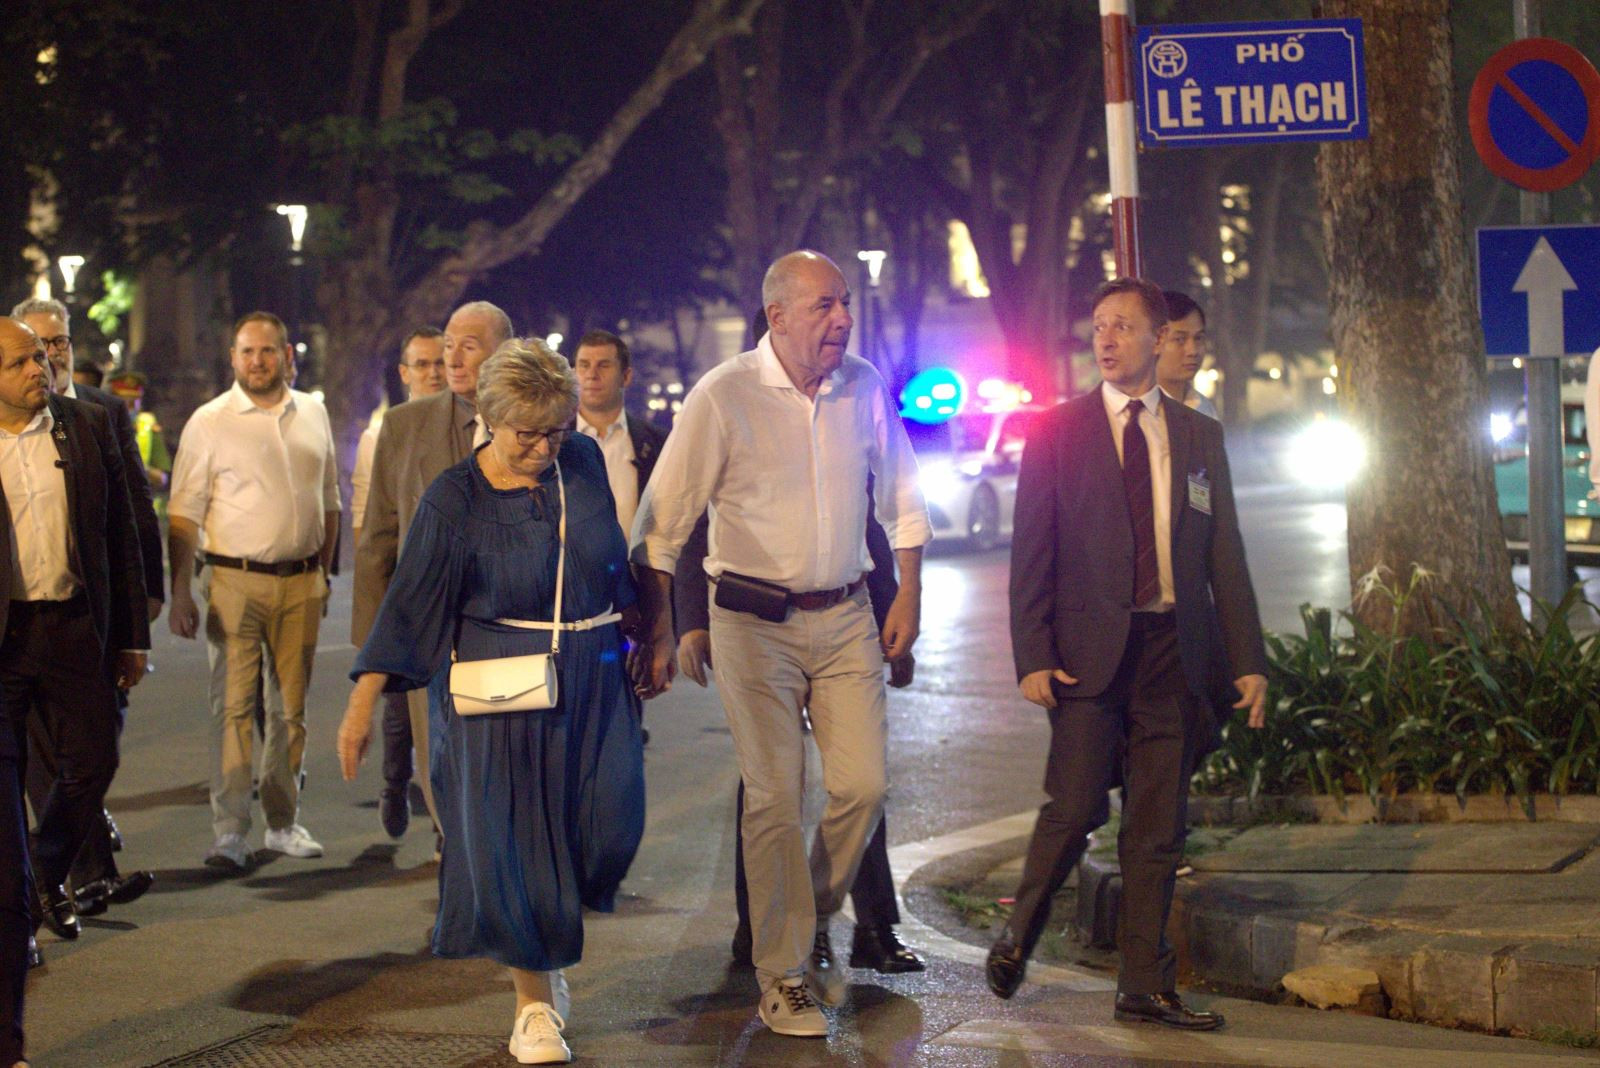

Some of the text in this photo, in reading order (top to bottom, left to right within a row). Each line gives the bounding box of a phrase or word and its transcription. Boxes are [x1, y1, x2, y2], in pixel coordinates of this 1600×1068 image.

[1236, 33, 1306, 64] PHỐ
[1157, 78, 1347, 132] LÊ THẠCH
